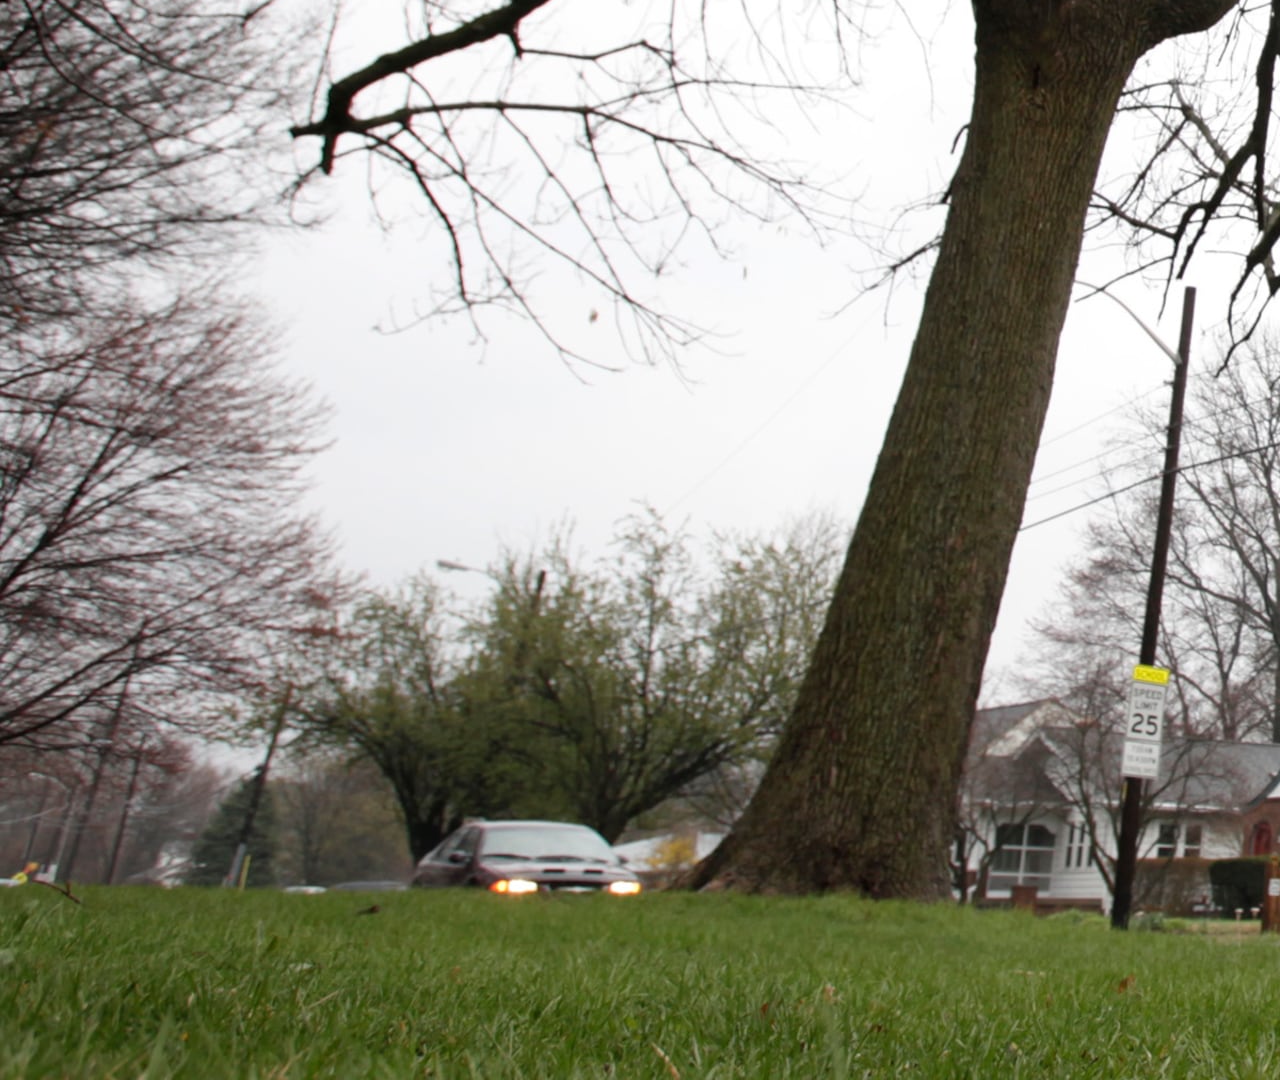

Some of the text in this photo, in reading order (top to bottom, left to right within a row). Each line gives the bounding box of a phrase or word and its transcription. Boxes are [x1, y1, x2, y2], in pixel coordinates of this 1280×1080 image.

[1135, 668, 1165, 682] SCHOOL
[1133, 687, 1162, 700] SPEED
[1134, 700, 1158, 710] LIMIT
[1131, 713, 1158, 735] 25
